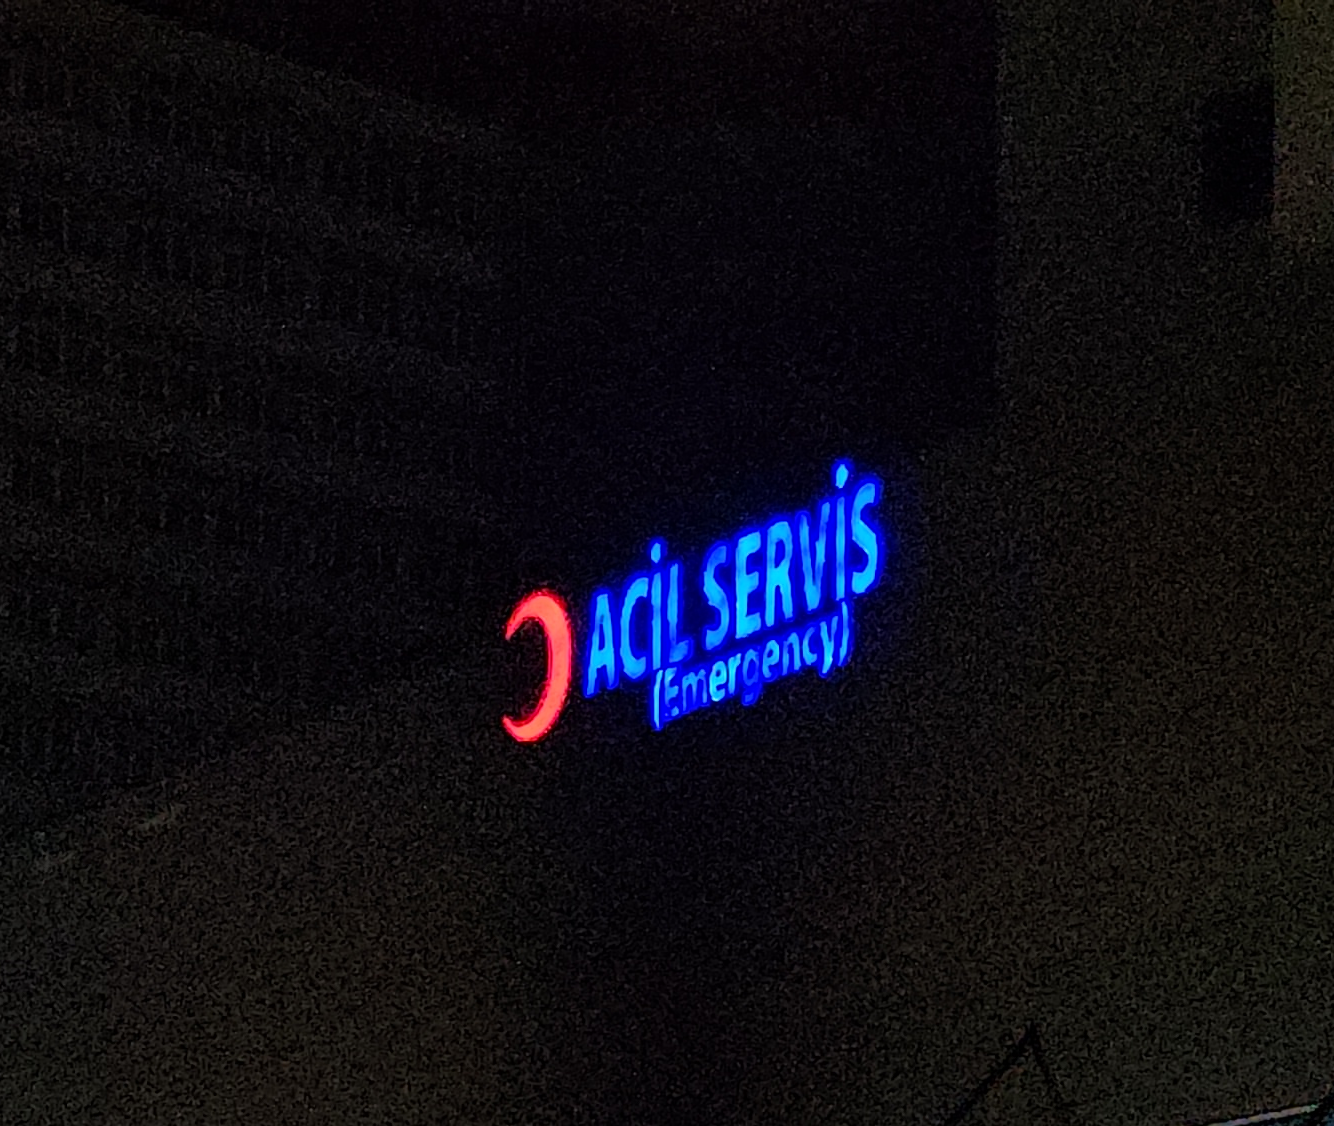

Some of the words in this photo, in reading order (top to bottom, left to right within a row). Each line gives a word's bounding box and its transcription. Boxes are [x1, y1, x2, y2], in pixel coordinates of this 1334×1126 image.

[584, 541, 693, 697] ACİL
[702, 461, 881, 651] SERVİS
[653, 600, 854, 730] (Emergency)
